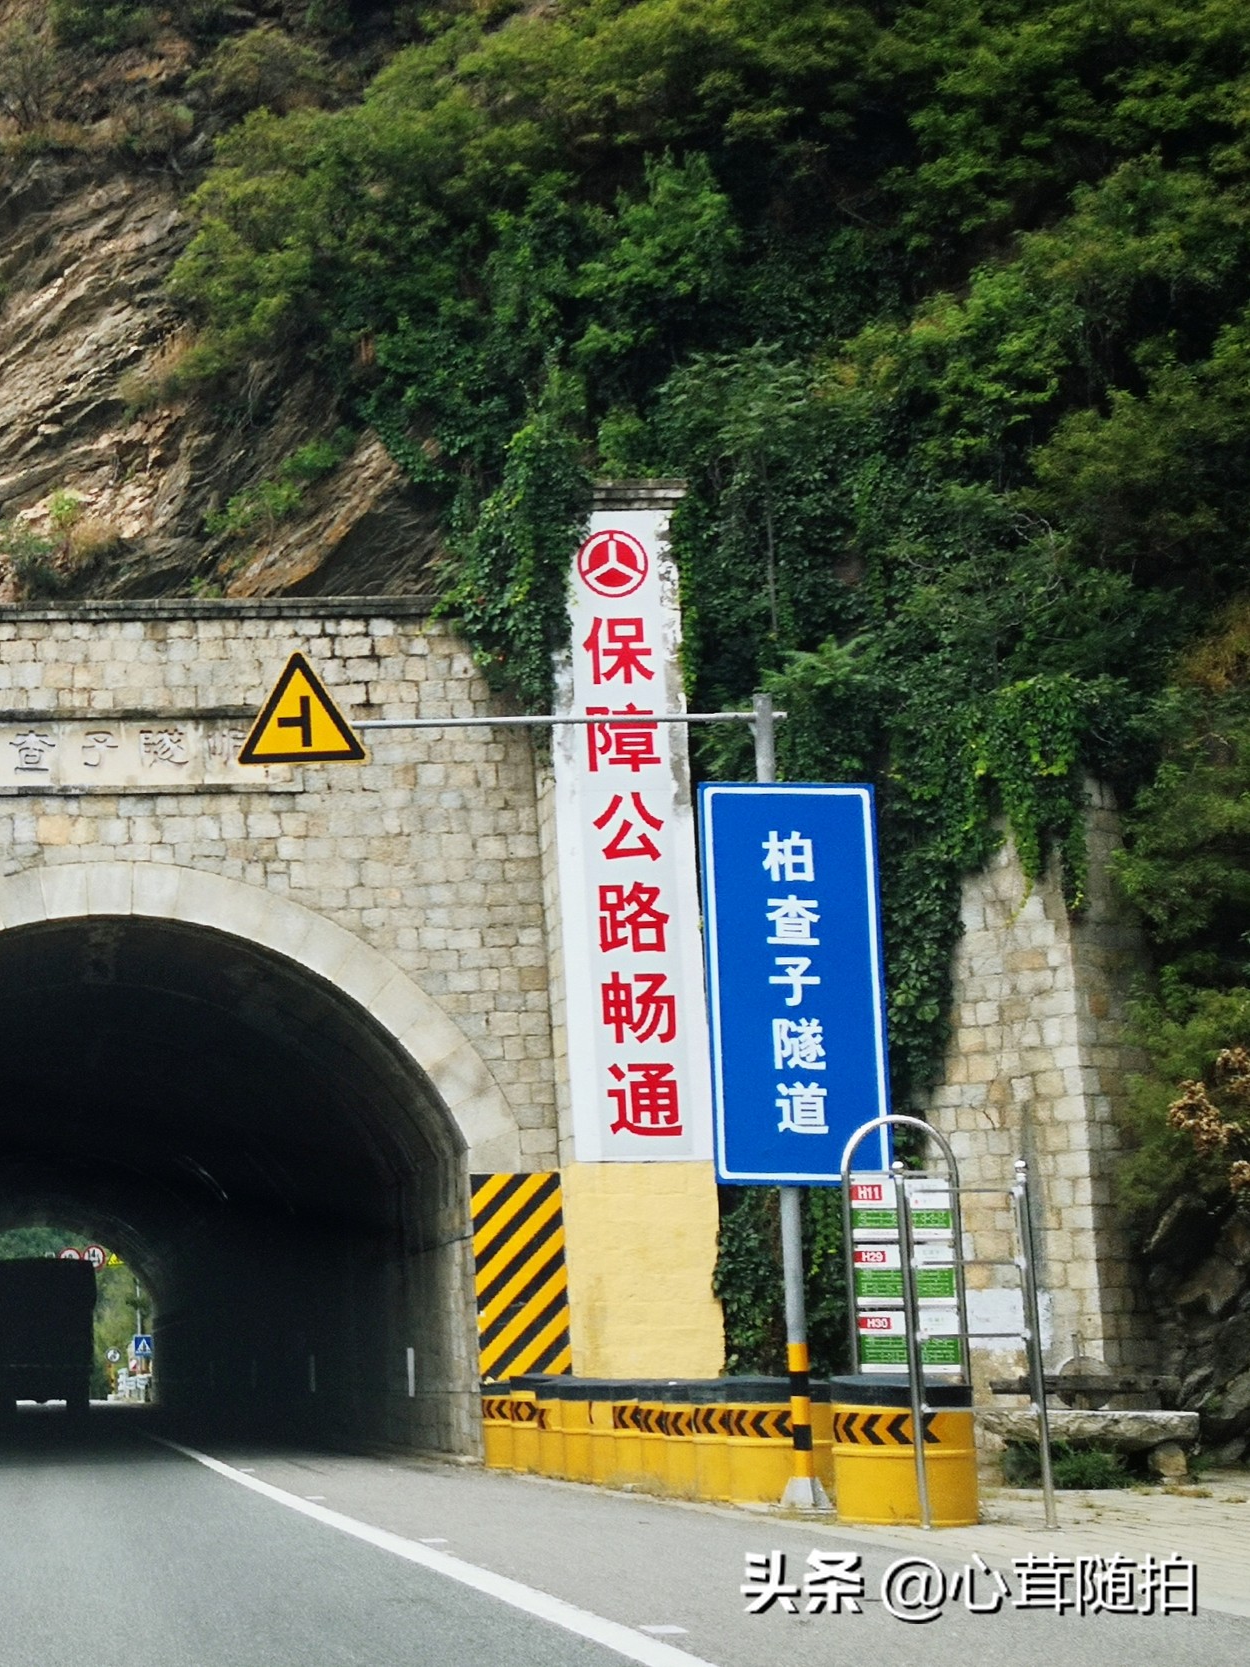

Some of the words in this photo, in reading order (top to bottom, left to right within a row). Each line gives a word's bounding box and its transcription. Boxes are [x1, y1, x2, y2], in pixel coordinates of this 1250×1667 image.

[582, 617, 684, 1137] 保障公路畅通
[762, 830, 829, 1135] 柏查子隧道
[857, 1185, 881, 1200] H11
[861, 1251, 884, 1262] H29
[866, 1318, 889, 1329] H30
